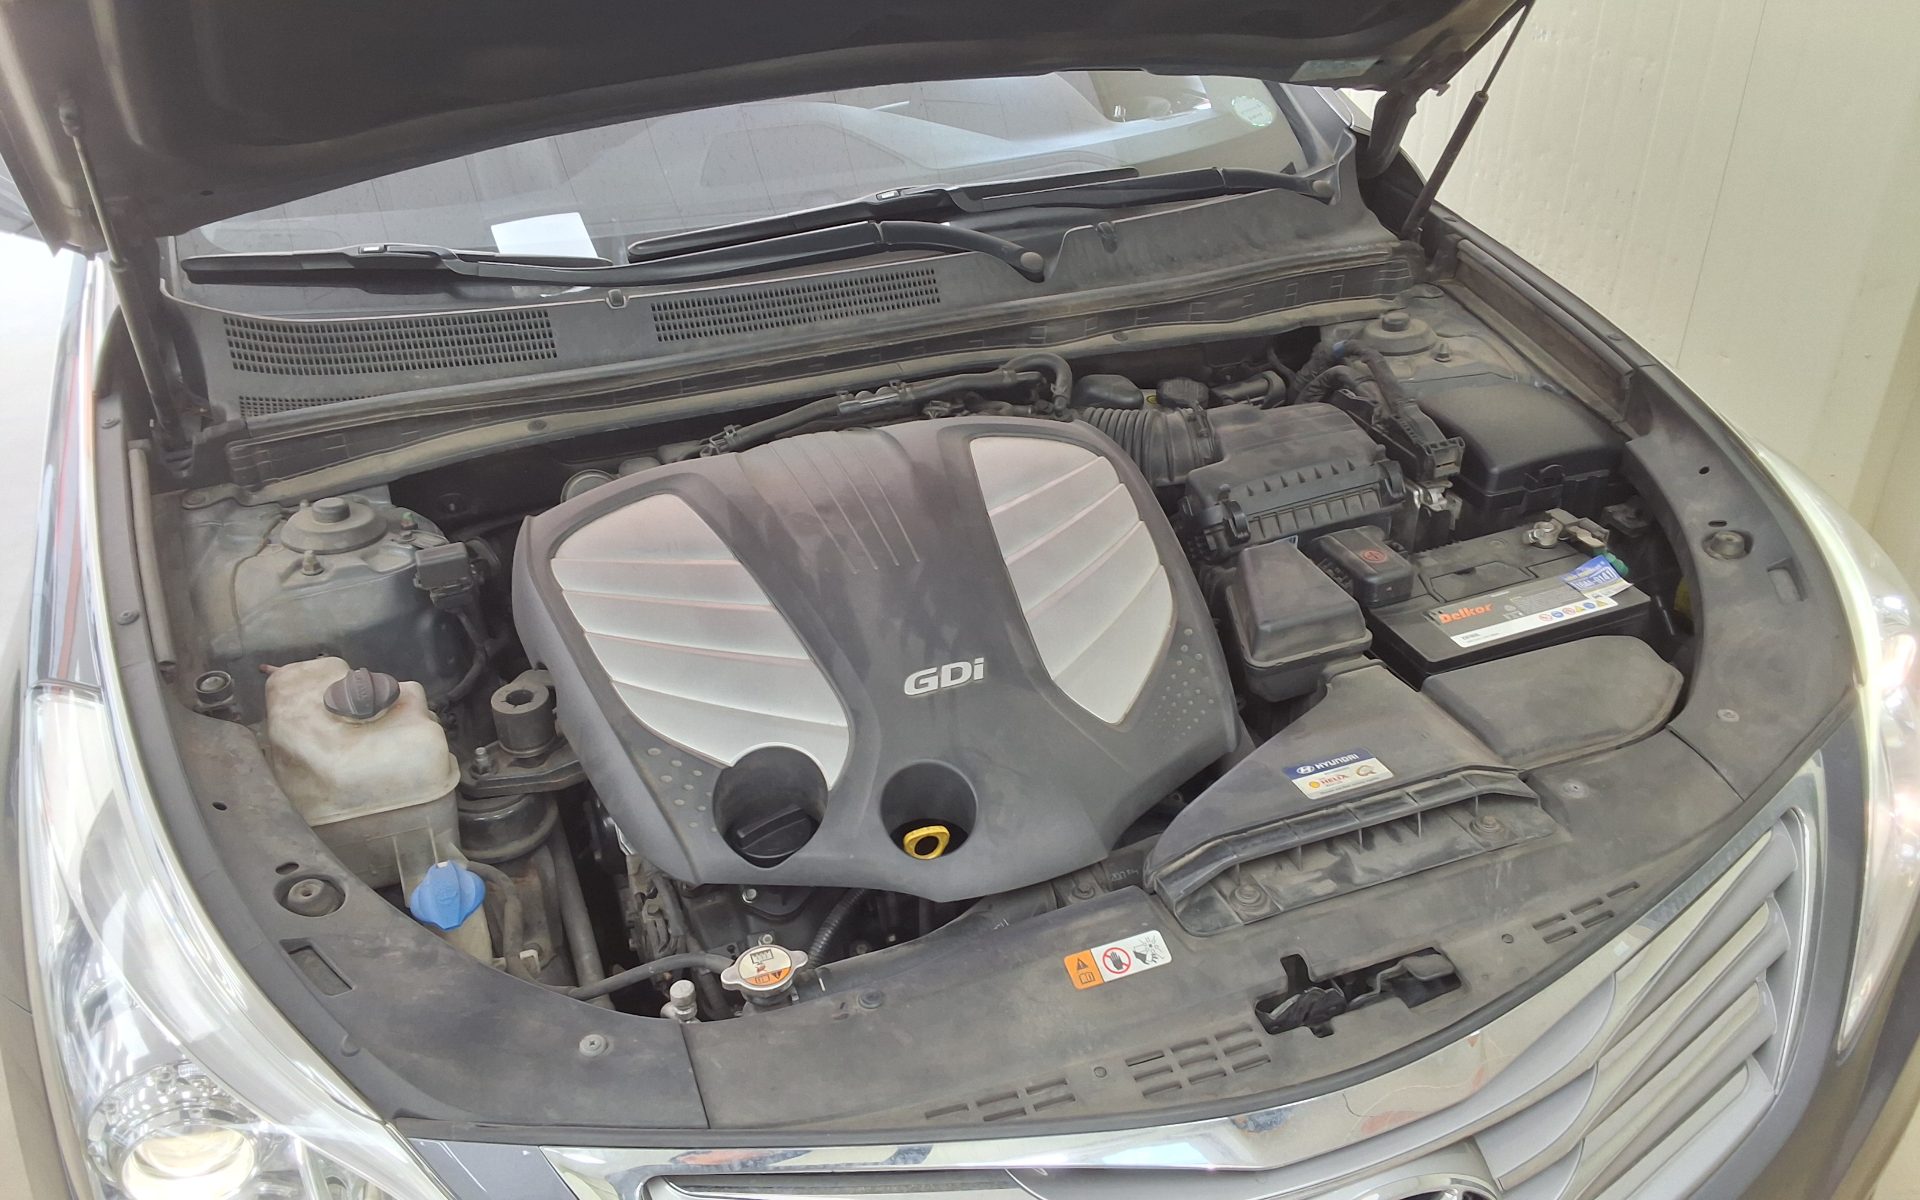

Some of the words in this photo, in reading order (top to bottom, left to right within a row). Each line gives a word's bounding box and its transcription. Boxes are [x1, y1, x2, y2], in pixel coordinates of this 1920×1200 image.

[1438, 601, 1494, 625] Delkor
[903, 656, 985, 697] GDi
[1314, 753, 1360, 770] HYUNDAI
[1321, 774, 1350, 785] HELIX
